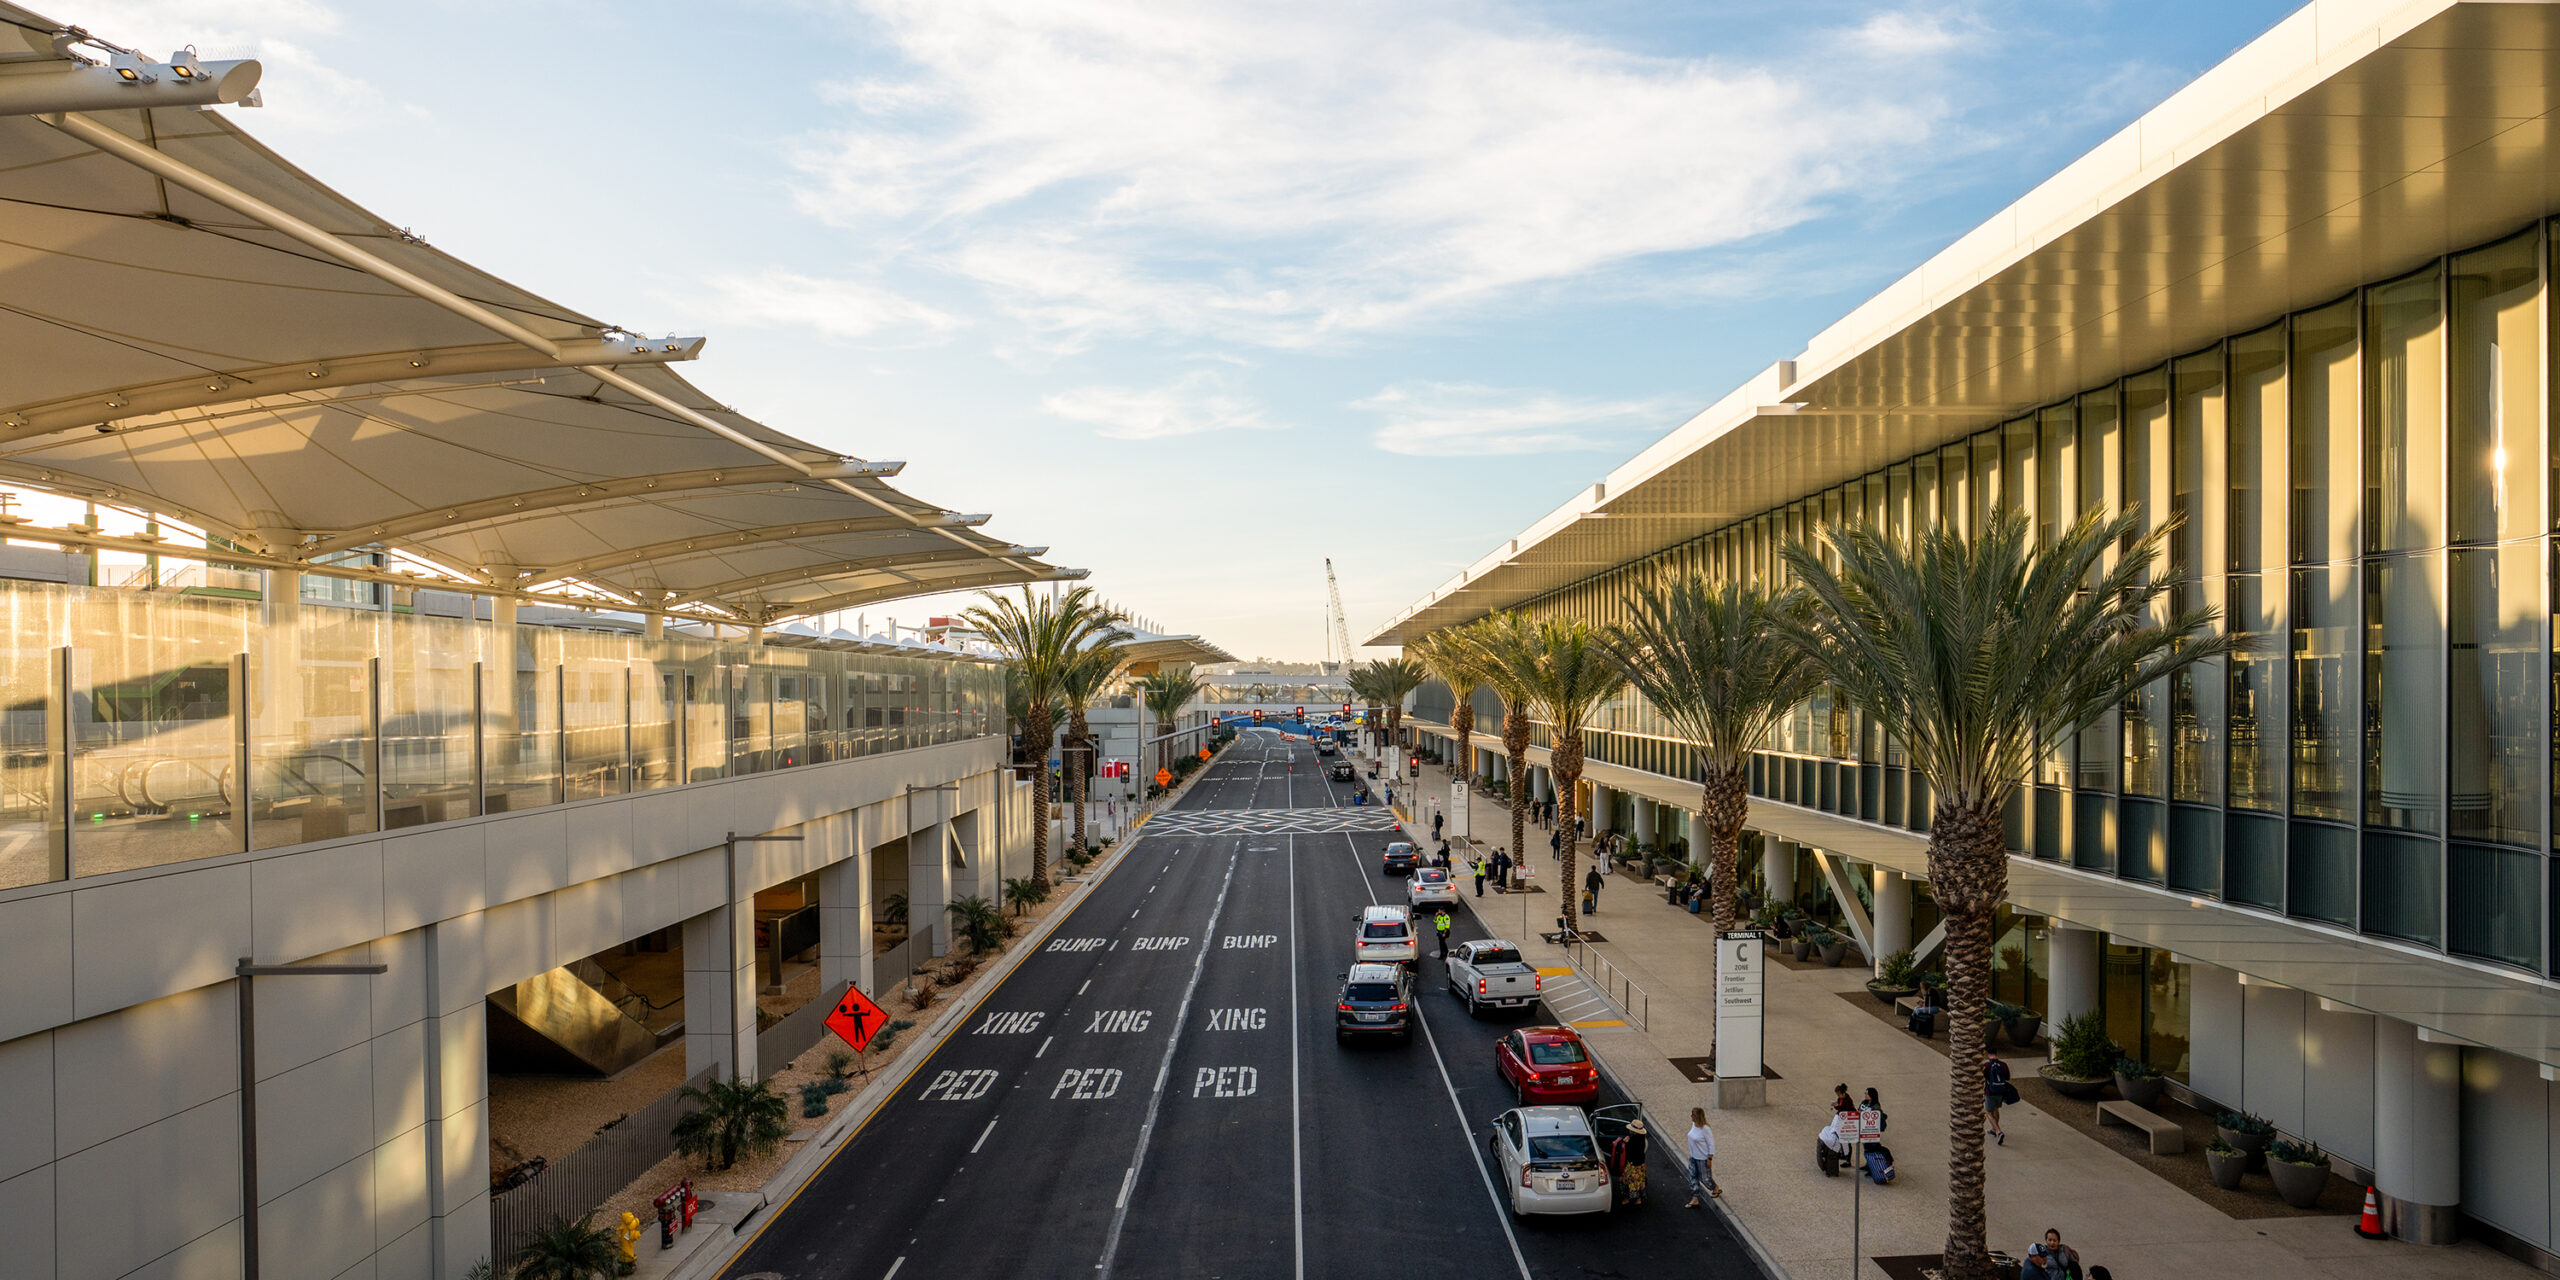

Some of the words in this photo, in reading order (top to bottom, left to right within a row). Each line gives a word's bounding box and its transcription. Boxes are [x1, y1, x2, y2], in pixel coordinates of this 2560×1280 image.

[1045, 938, 1107, 952] BUMP
[1131, 937, 1190, 951] BUMP
[1222, 935, 1278, 949] BUMP
[1736, 943, 1748, 962] C
[972, 1010, 1046, 1035] XING
[1083, 1010, 1153, 1033] XING
[1205, 1008, 1267, 1032] XING
[917, 1068, 999, 1101] PED
[1050, 1068, 1123, 1100] PED
[1192, 1066, 1258, 1098] PED
